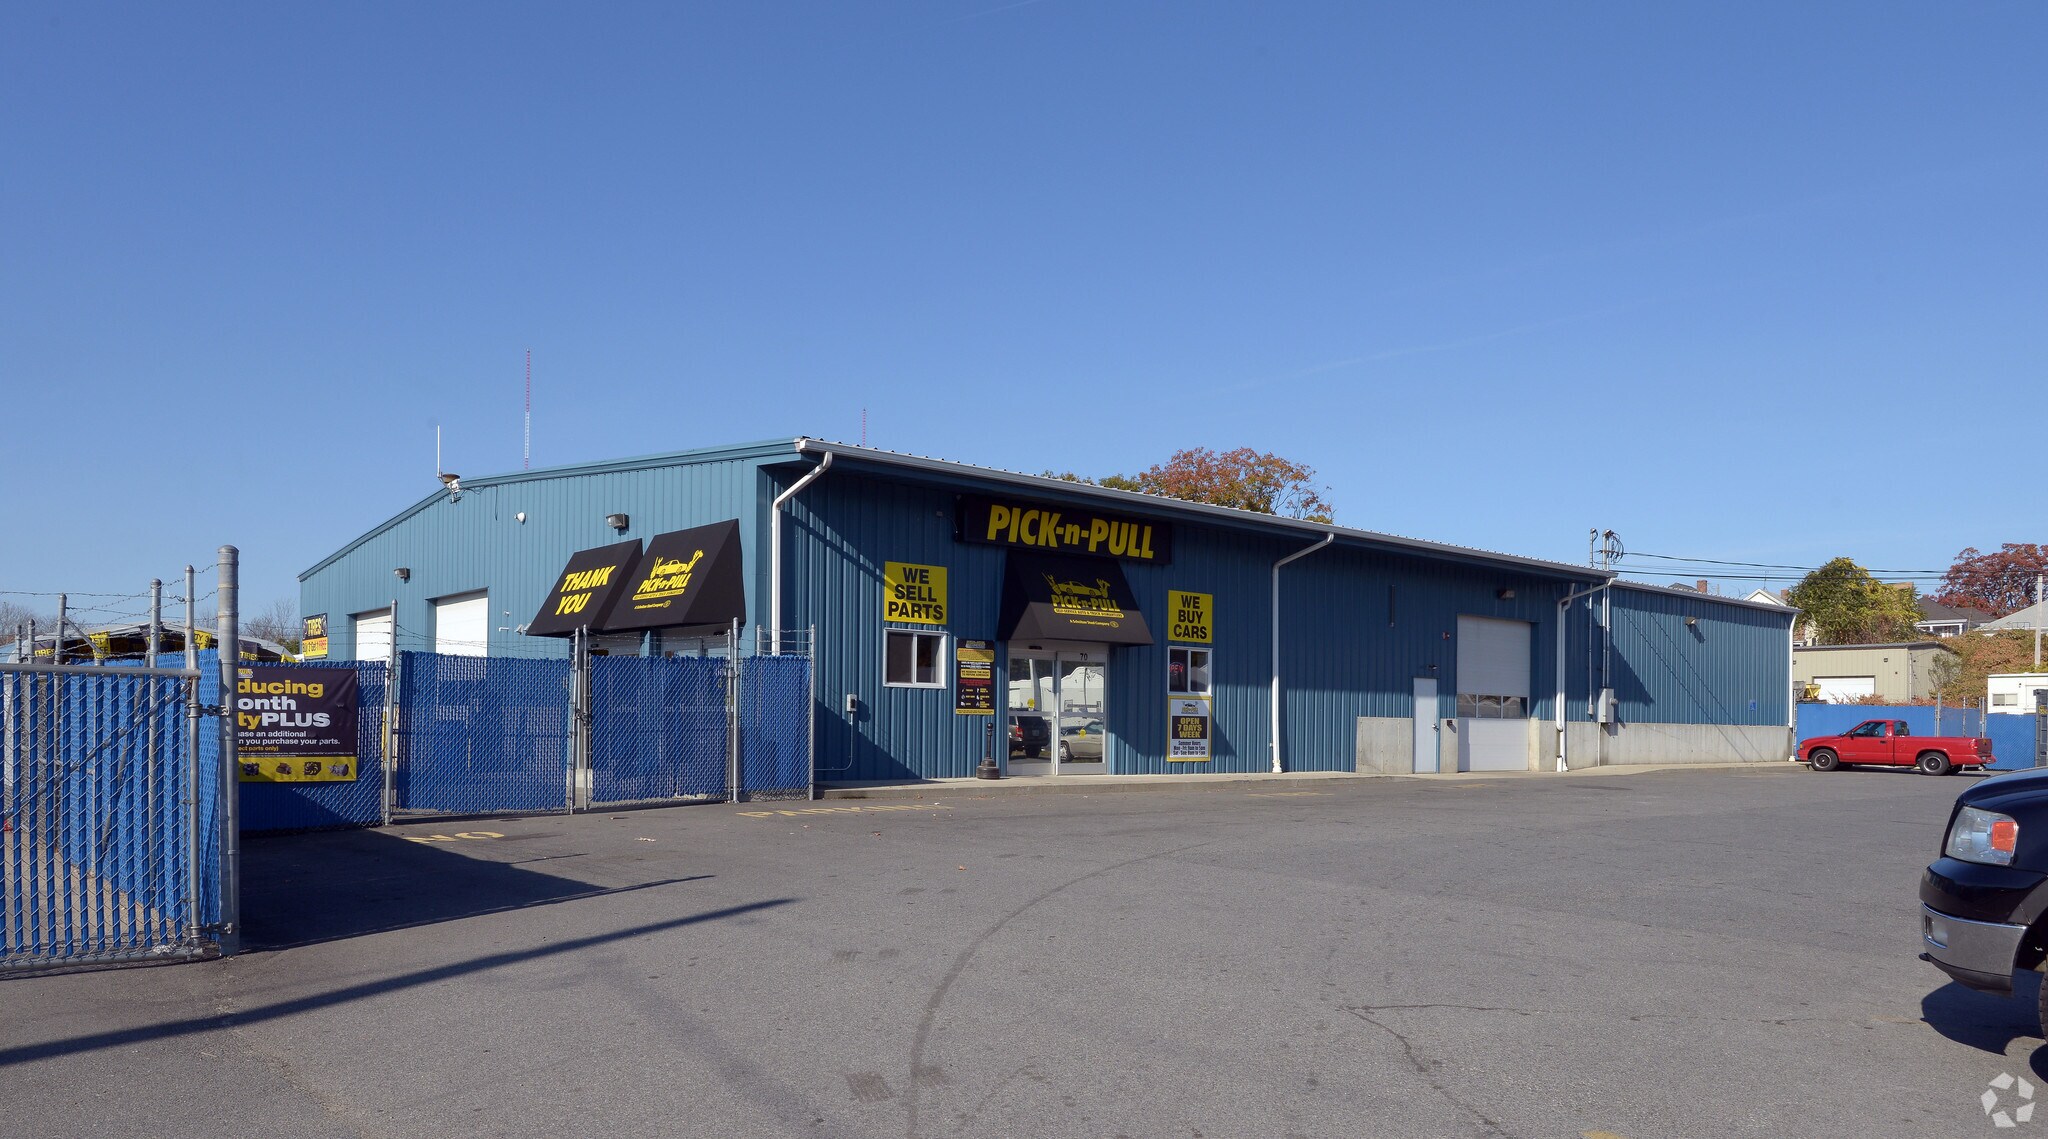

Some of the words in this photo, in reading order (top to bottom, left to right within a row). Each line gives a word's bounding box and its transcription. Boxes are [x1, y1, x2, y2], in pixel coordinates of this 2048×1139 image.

[986, 504, 1154, 559] PICK-n-PULL
[559, 565, 617, 593] THANK
[636, 573, 692, 594] PICK-n-PULL
[902, 567, 930, 585] WE
[894, 584, 937, 602] SELL
[1181, 594, 1200, 609] WE
[555, 592, 592, 616] YOU
[888, 601, 944, 620] PARTS
[1051, 594, 1121, 612] PICK-n-PULL
[1178, 609, 1204, 624] BUY
[1173, 623, 1208, 640] CARS
[238, 679, 324, 698] ducing
[238, 696, 297, 711] onth
[238, 712, 331, 729] tyPLUS
[1180, 717, 1200, 725] OPEN
[1183, 724, 1203, 732] DAYS
[262, 738, 299, 746] purchase
[268, 730, 307, 738] additional
